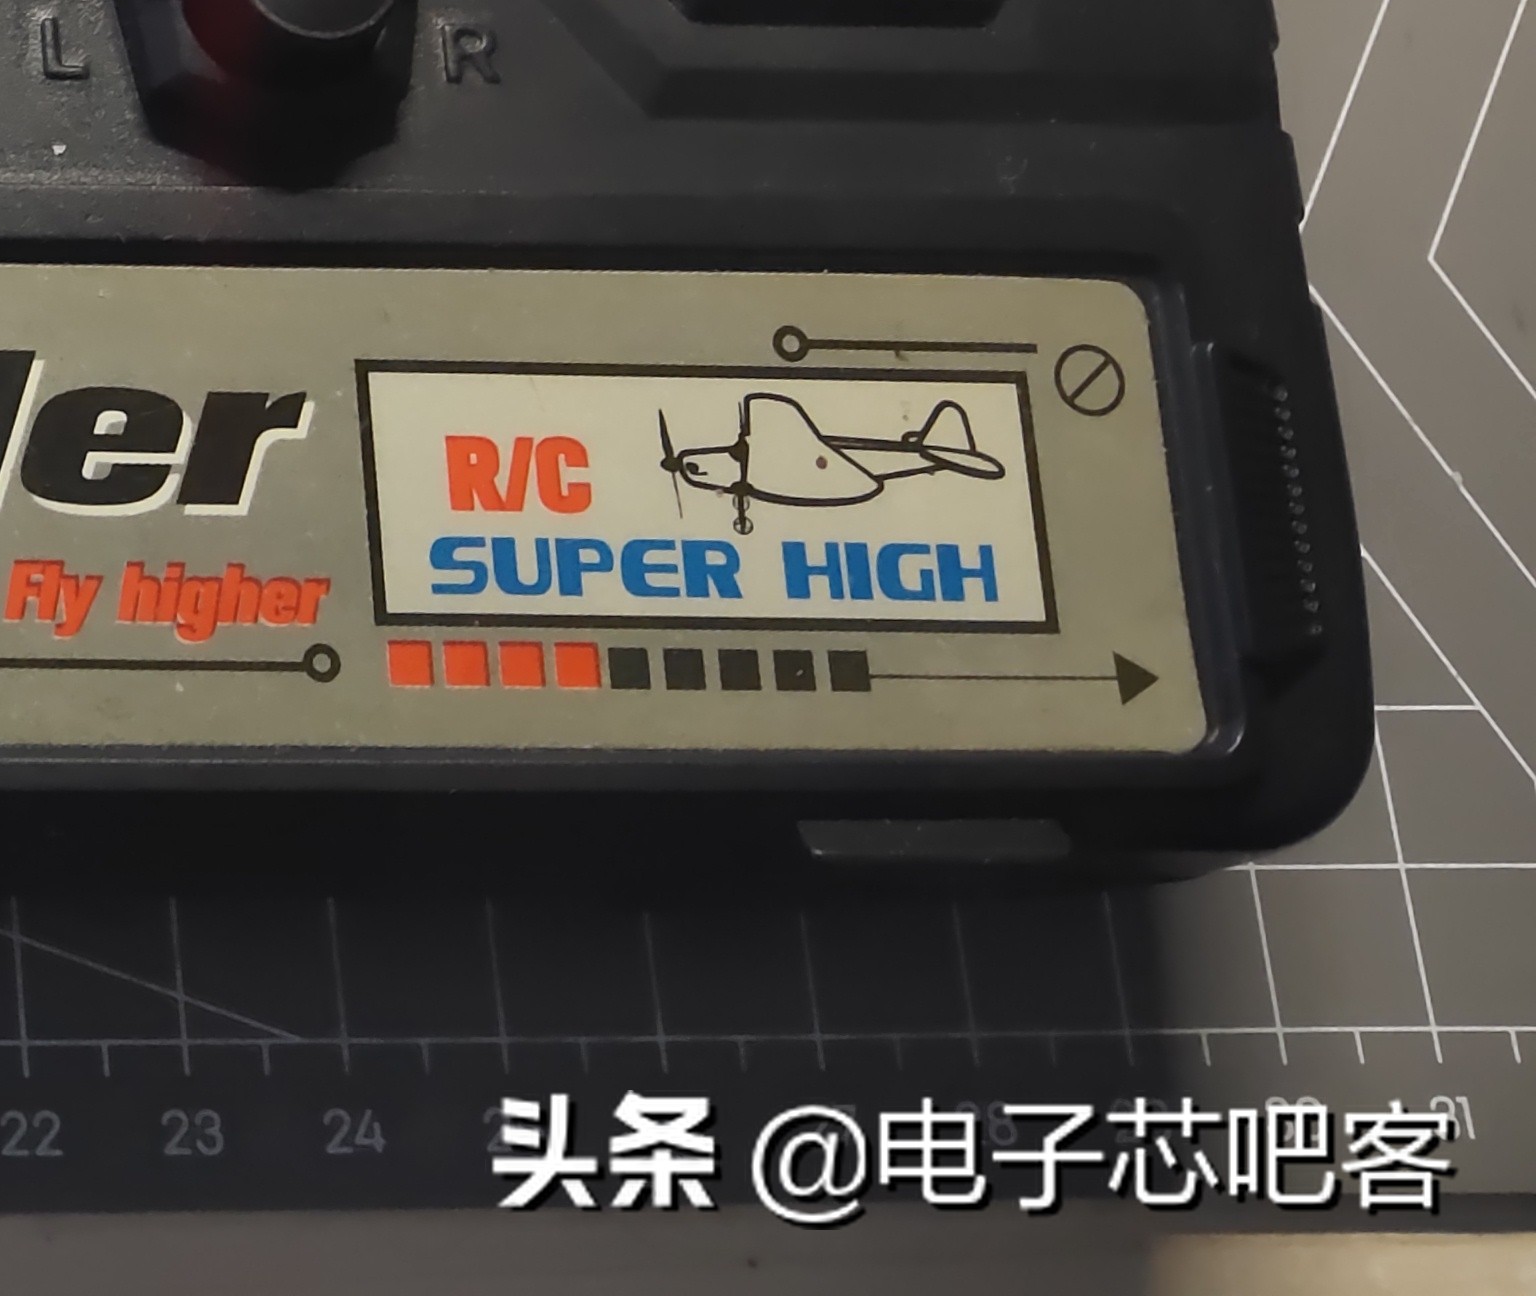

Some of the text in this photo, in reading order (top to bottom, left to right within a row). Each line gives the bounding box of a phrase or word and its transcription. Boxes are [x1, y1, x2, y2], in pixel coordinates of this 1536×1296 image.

[40, 16, 90, 80] L
[439, 22, 501, 84] R
[445, 434, 593, 513] R/C
[3, 559, 330, 642] Fly higher
[429, 536, 1000, 604] SUPER HIGH
[1, 1112, 64, 1159] 22
[162, 1109, 226, 1157] 23
[325, 1108, 388, 1156] 24
